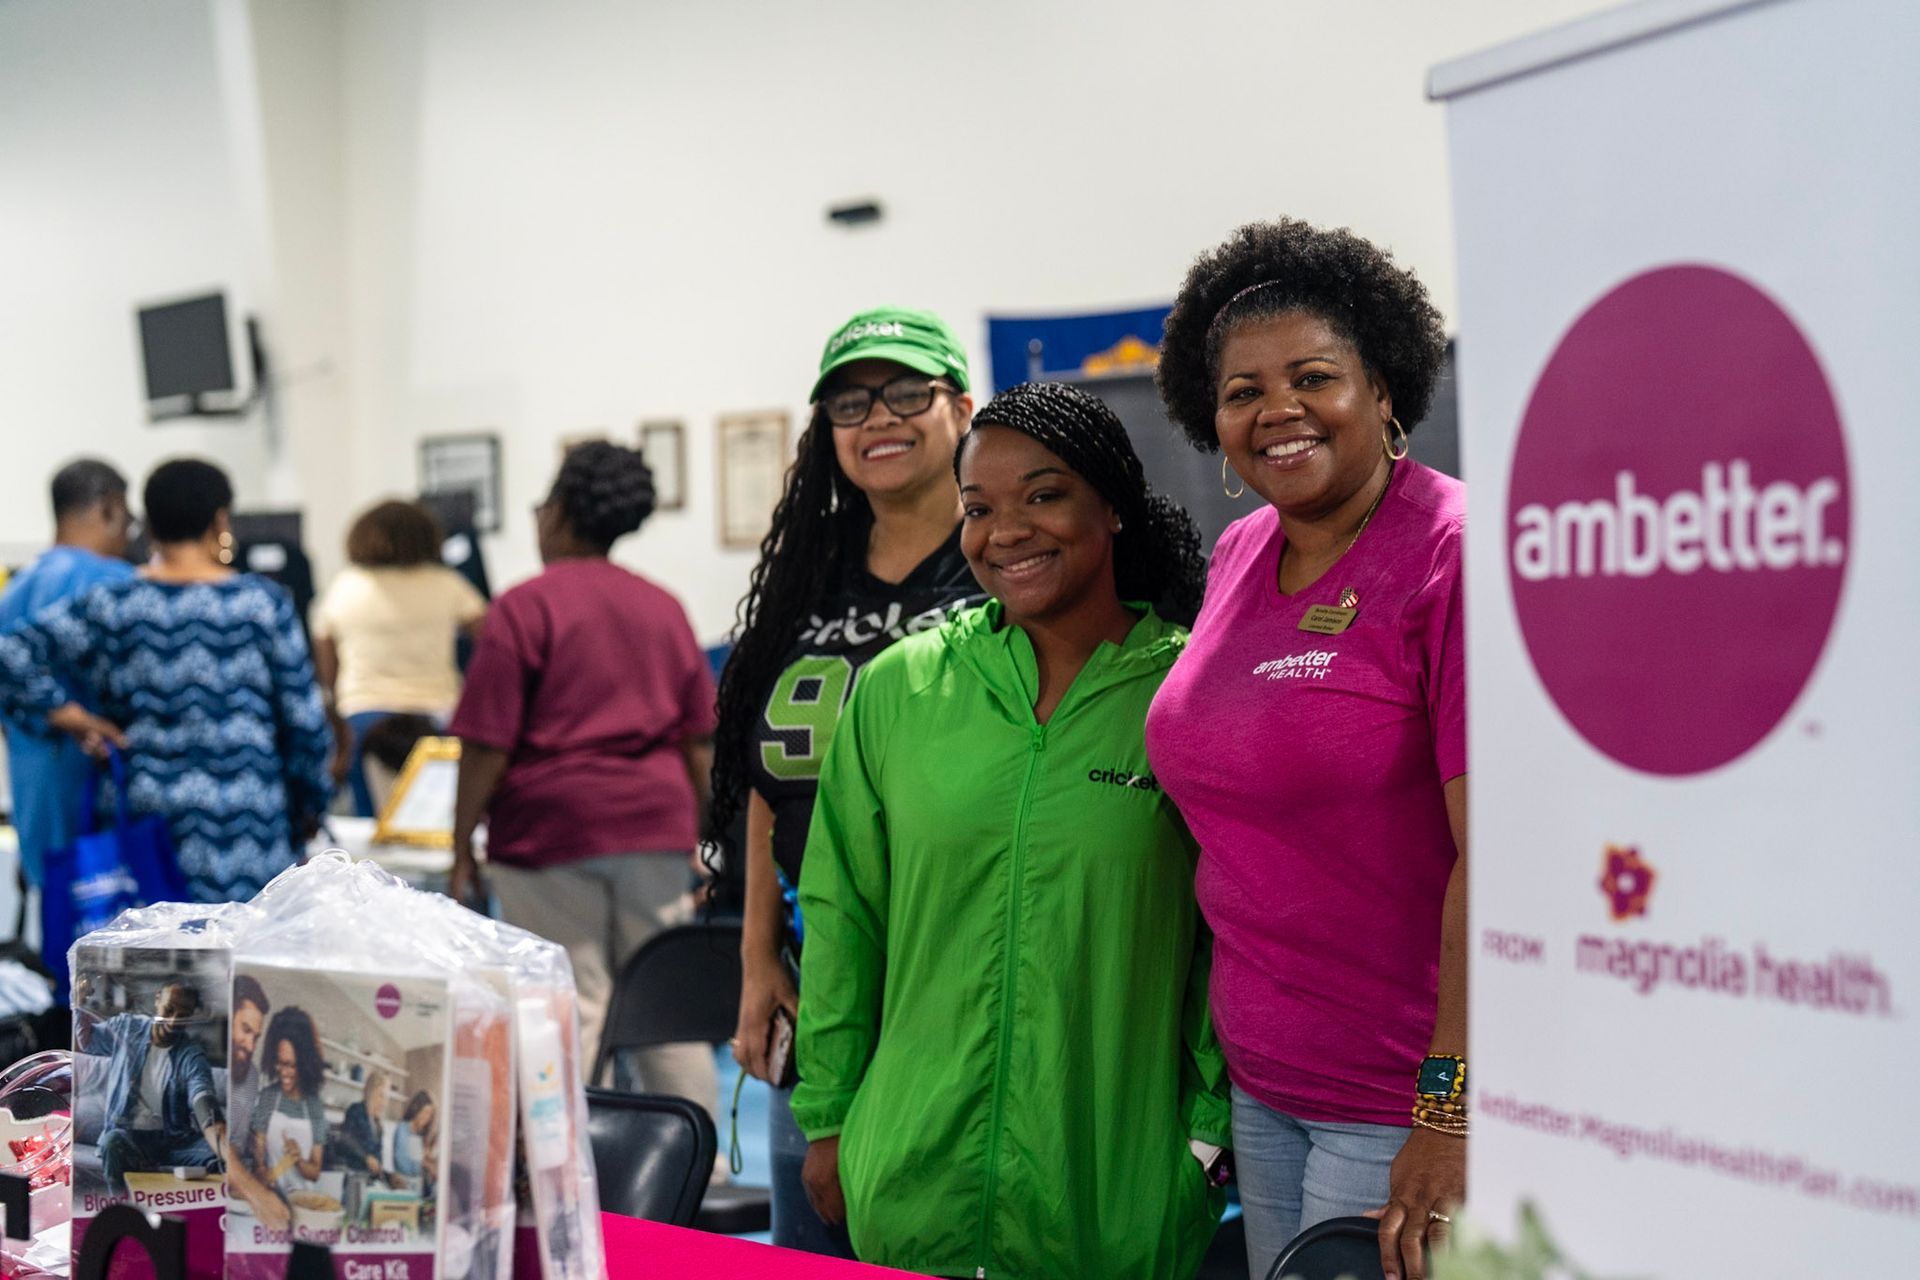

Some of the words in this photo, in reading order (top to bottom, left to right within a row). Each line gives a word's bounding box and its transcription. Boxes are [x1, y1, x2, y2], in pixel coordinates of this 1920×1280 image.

[1513, 457, 1845, 582] ambetter.
[1252, 649, 1338, 675] ambetter
[760, 655, 866, 781] 9
[1088, 767, 1160, 793] cricket
[1575, 931, 1745, 996] magnolia
[134, 1187, 216, 1207] Pressure
[253, 1225, 294, 1244] Blood
[344, 1259, 383, 1280] Care
[384, 1259, 409, 1280] Kit
